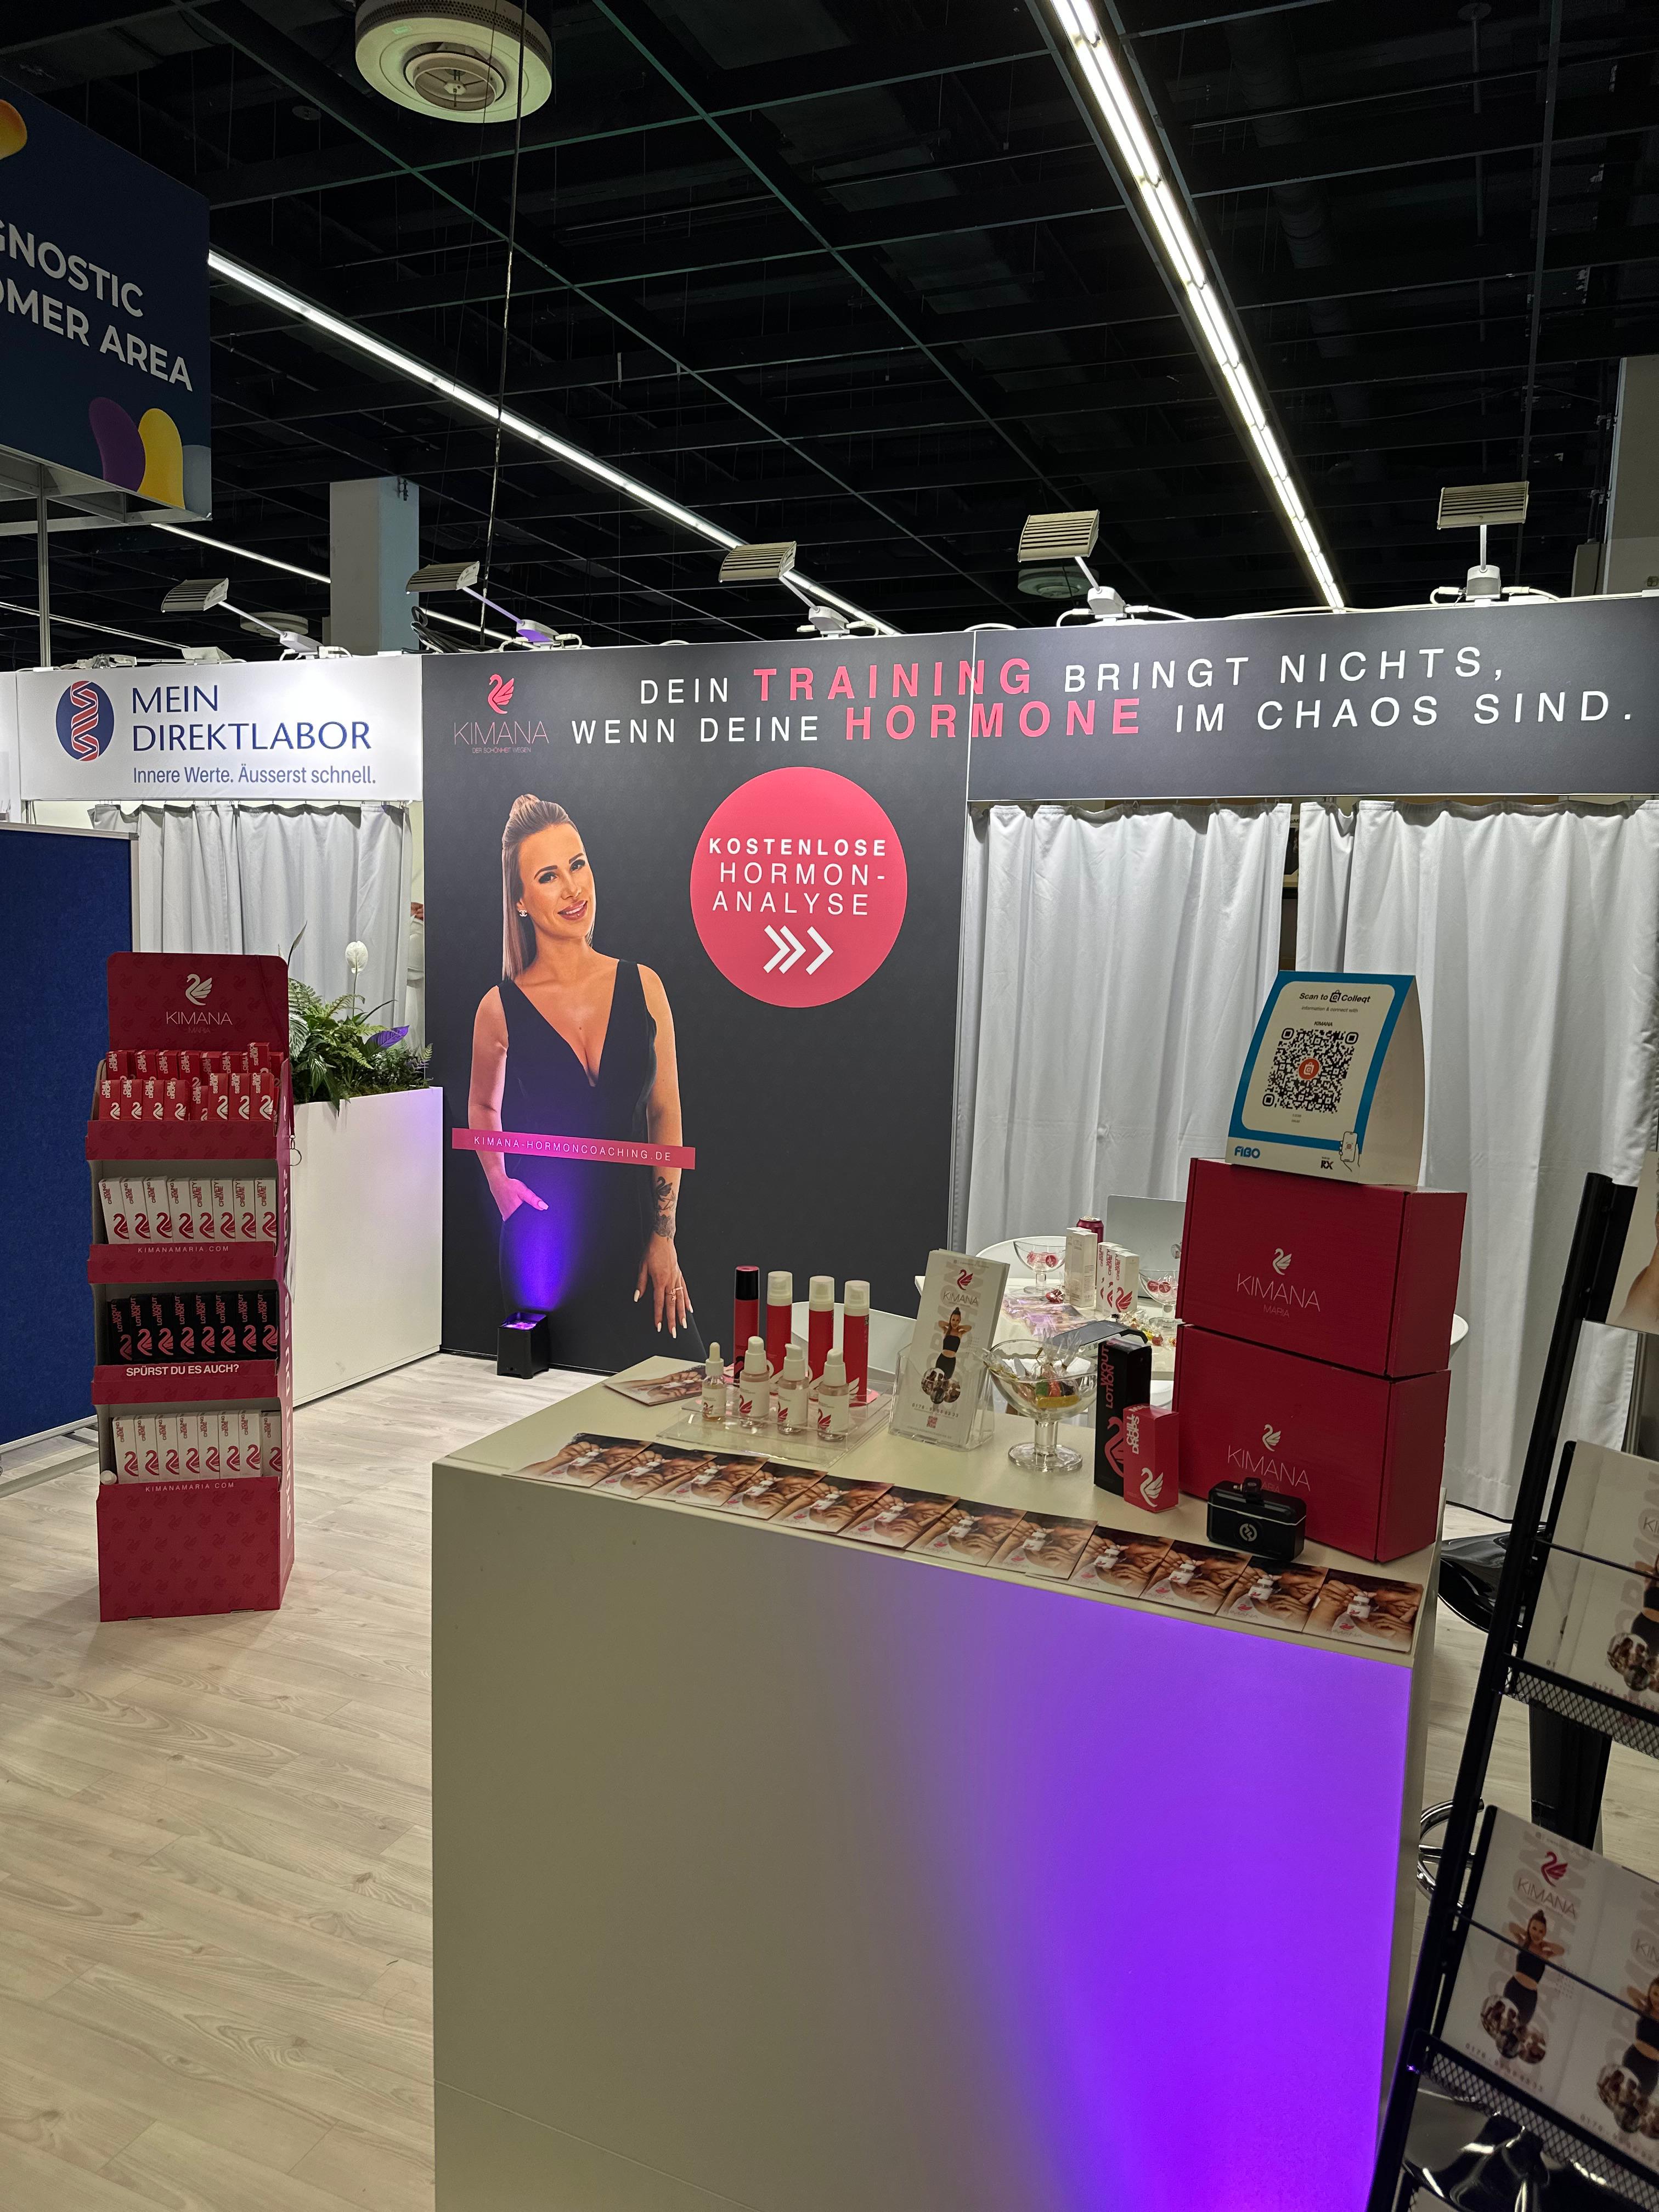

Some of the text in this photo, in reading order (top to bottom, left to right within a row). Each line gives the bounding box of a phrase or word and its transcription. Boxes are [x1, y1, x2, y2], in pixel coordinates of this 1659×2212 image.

[0, 221, 143, 317] NOSTIC
[0, 278, 193, 392] MER AREA
[641, 646, 1503, 704] DEIN TRAINING BRINGT NICHTS,
[132, 684, 218, 714] MEIN
[572, 690, 1632, 744] WENN DEINE HORMONE IM CHAOS SIND.
[133, 720, 372, 751] DIREKTLABOR
[454, 720, 550, 745] KIMANA
[133, 763, 377, 784] Innere Werte. Äusserst schnell.
[709, 838, 886, 856] KOSTENLOSE
[720, 862, 885, 887] HORMON-
[712, 890, 868, 916] ANALYSE
[1299, 992, 1318, 1001] Scan
[1341, 994, 1370, 1004] Colleqt
[166, 1011, 233, 1026] KIMANA
[188, 1026, 211, 1034] MARIA
[473, 1136, 672, 1161] KIMANA-HORMONCOACHING.DE
[1234, 1146, 1260, 1159] FIBO
[1321, 1160, 1334, 1170] RX
[943, 1290, 978, 1306] KIMANA
[1237, 1273, 1321, 1312] KIMANA
[1263, 1304, 1290, 1318] MARIA
[126, 1363, 240, 1377] SPÜRST DU ES AUCH?
[1105, 1364, 1114, 1409] LOTION
[1227, 1444, 1311, 1492] KIMANA
[1261, 1481, 1280, 1493] ARIA
[1517, 1876, 1577, 1919] KIMANA
